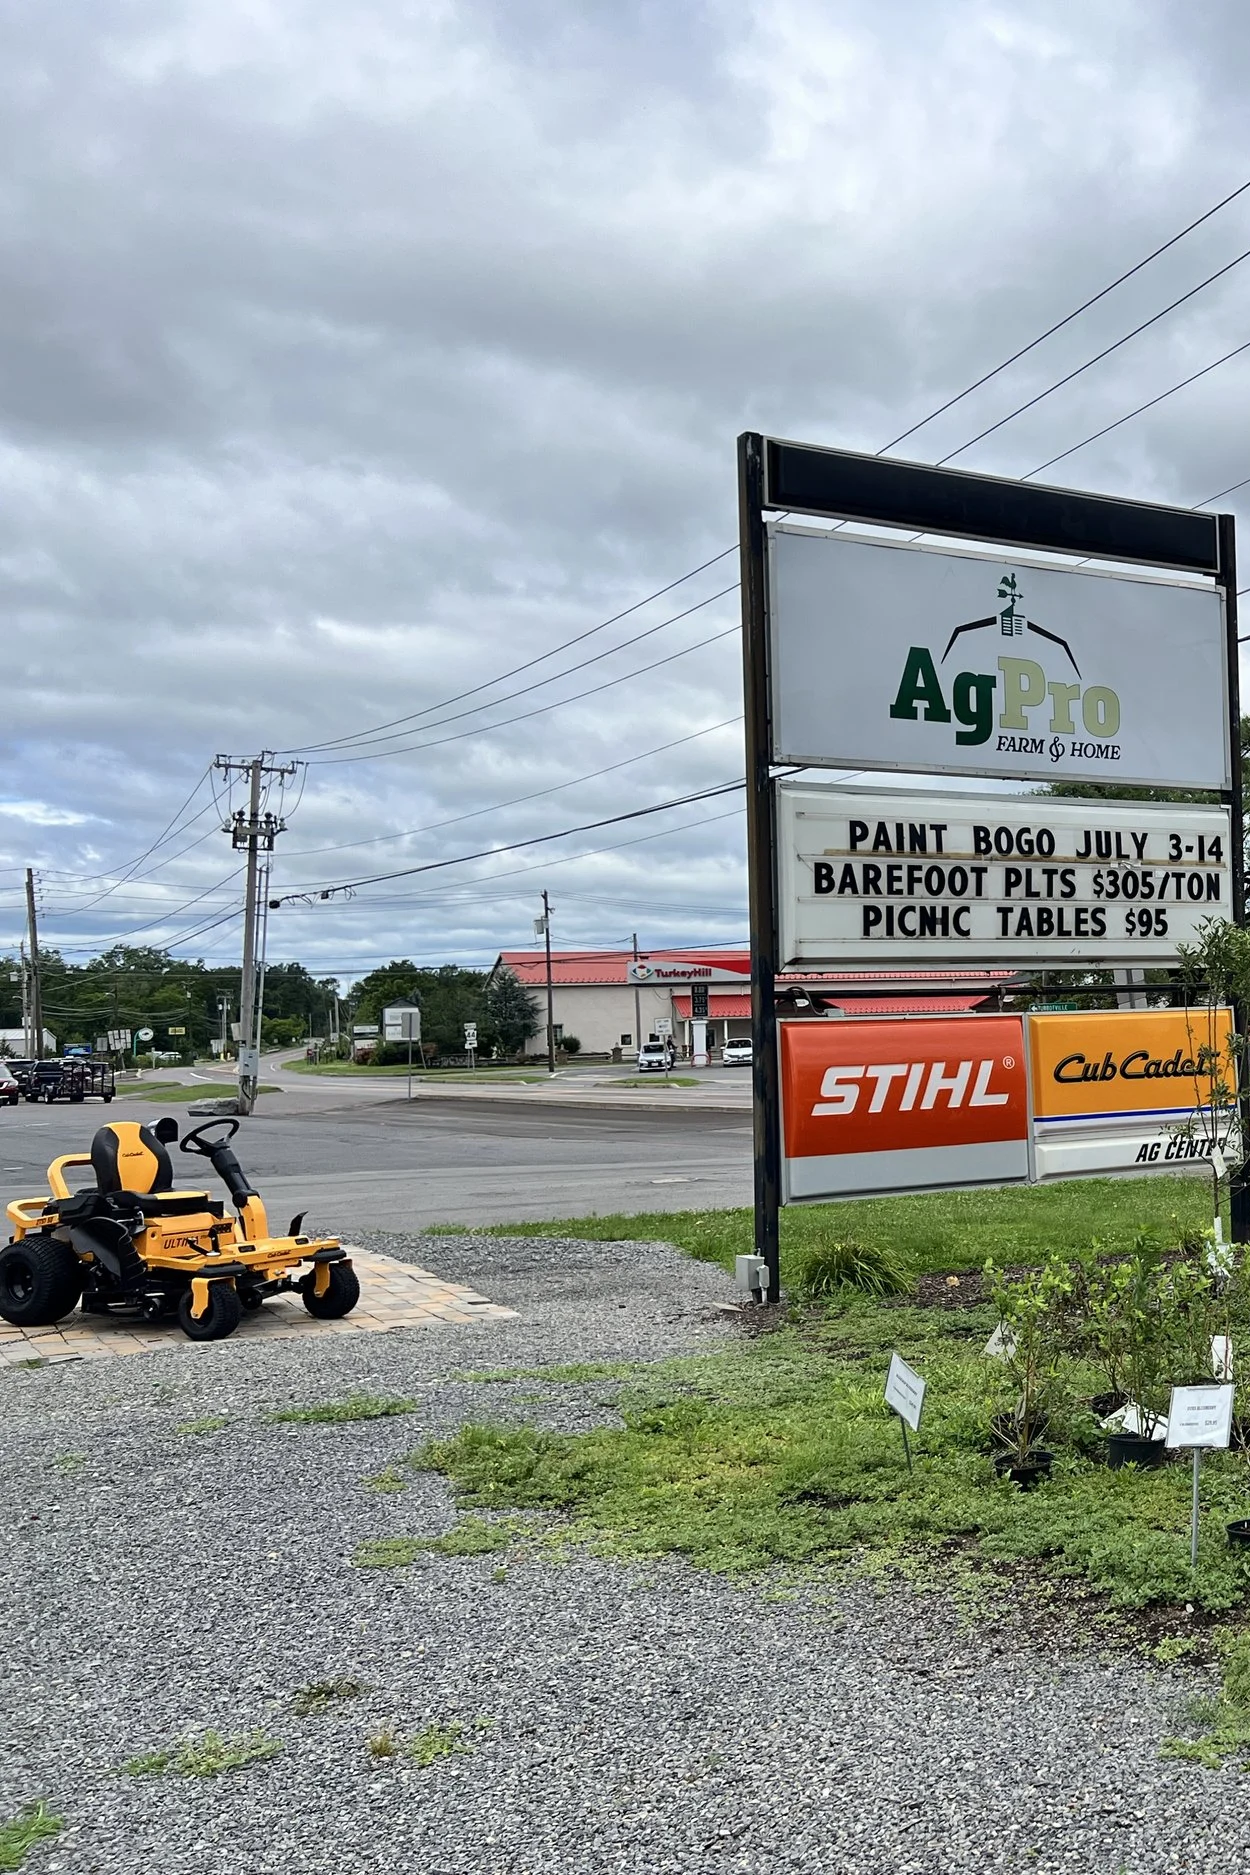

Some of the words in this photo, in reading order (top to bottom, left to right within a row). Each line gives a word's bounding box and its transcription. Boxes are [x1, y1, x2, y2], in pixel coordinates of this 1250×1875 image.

[889, 646, 1121, 745] AgPro
[996, 735, 1045, 755] FARM
[1049, 736, 1065, 762] &
[1070, 741, 1121, 760] HOME
[849, 820, 947, 854] PAINT
[973, 825, 1056, 858] BOGO
[1076, 829, 1148, 860] JULY
[1169, 833, 1224, 863] 3-14
[814, 862, 988, 897] BAREFOOT
[1004, 868, 1077, 899] PLTS
[1092, 869, 1221, 900] $305/TON
[862, 904, 971, 937] PICNIC
[996, 906, 1107, 937] TABLES
[1124, 908, 1169, 938] $95
[1053, 1052, 1117, 1083] Cub
[1119, 1049, 1221, 1080] Cadet
[1135, 1143, 1160, 1163] AG
